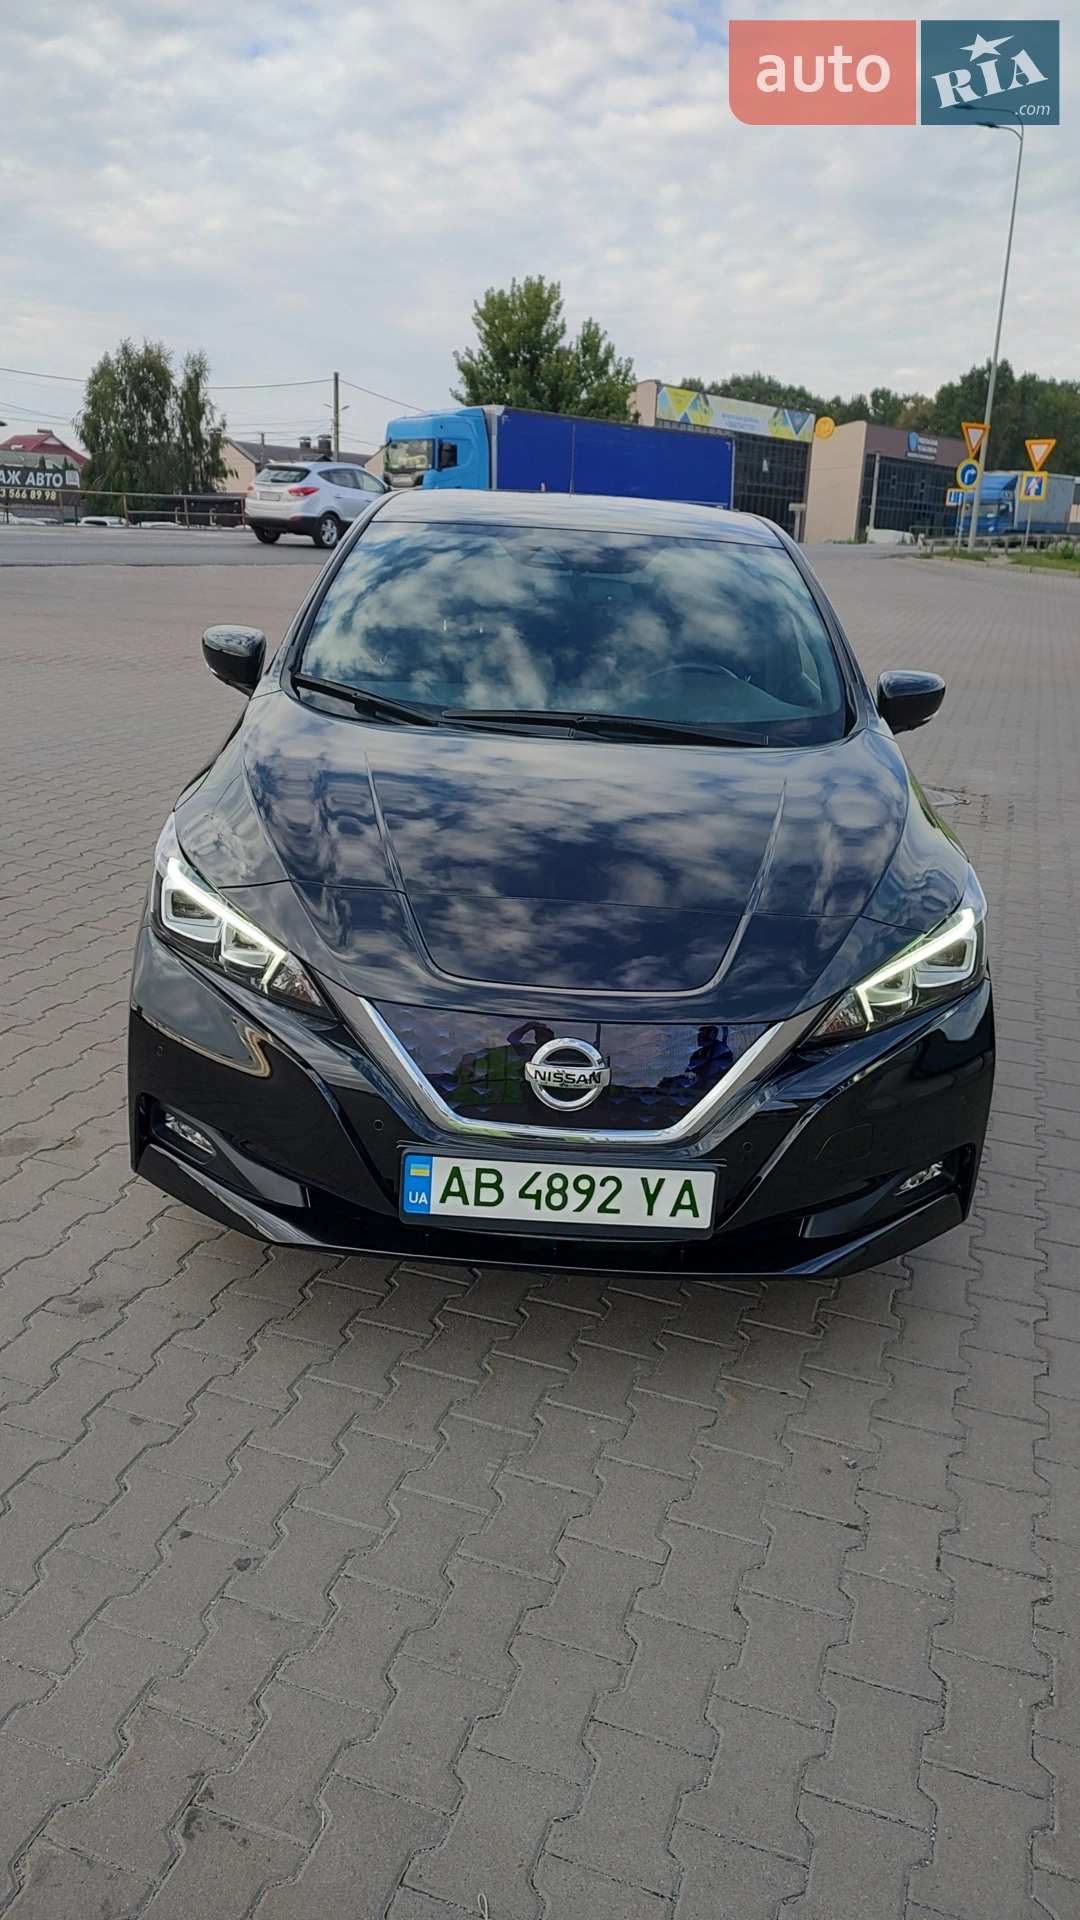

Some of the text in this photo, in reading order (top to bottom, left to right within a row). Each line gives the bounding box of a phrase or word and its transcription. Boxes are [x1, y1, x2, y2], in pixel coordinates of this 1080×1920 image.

[25, 471, 63, 487] АВТО
[9, 488, 27, 499] 566
[30, 490, 42, 500] 89
[45, 491, 57, 501] 98
[534, 1069, 602, 1085] NISSAN
[408, 1190, 429, 1205] UA
[439, 1166, 700, 1218] AB 4892 YA
